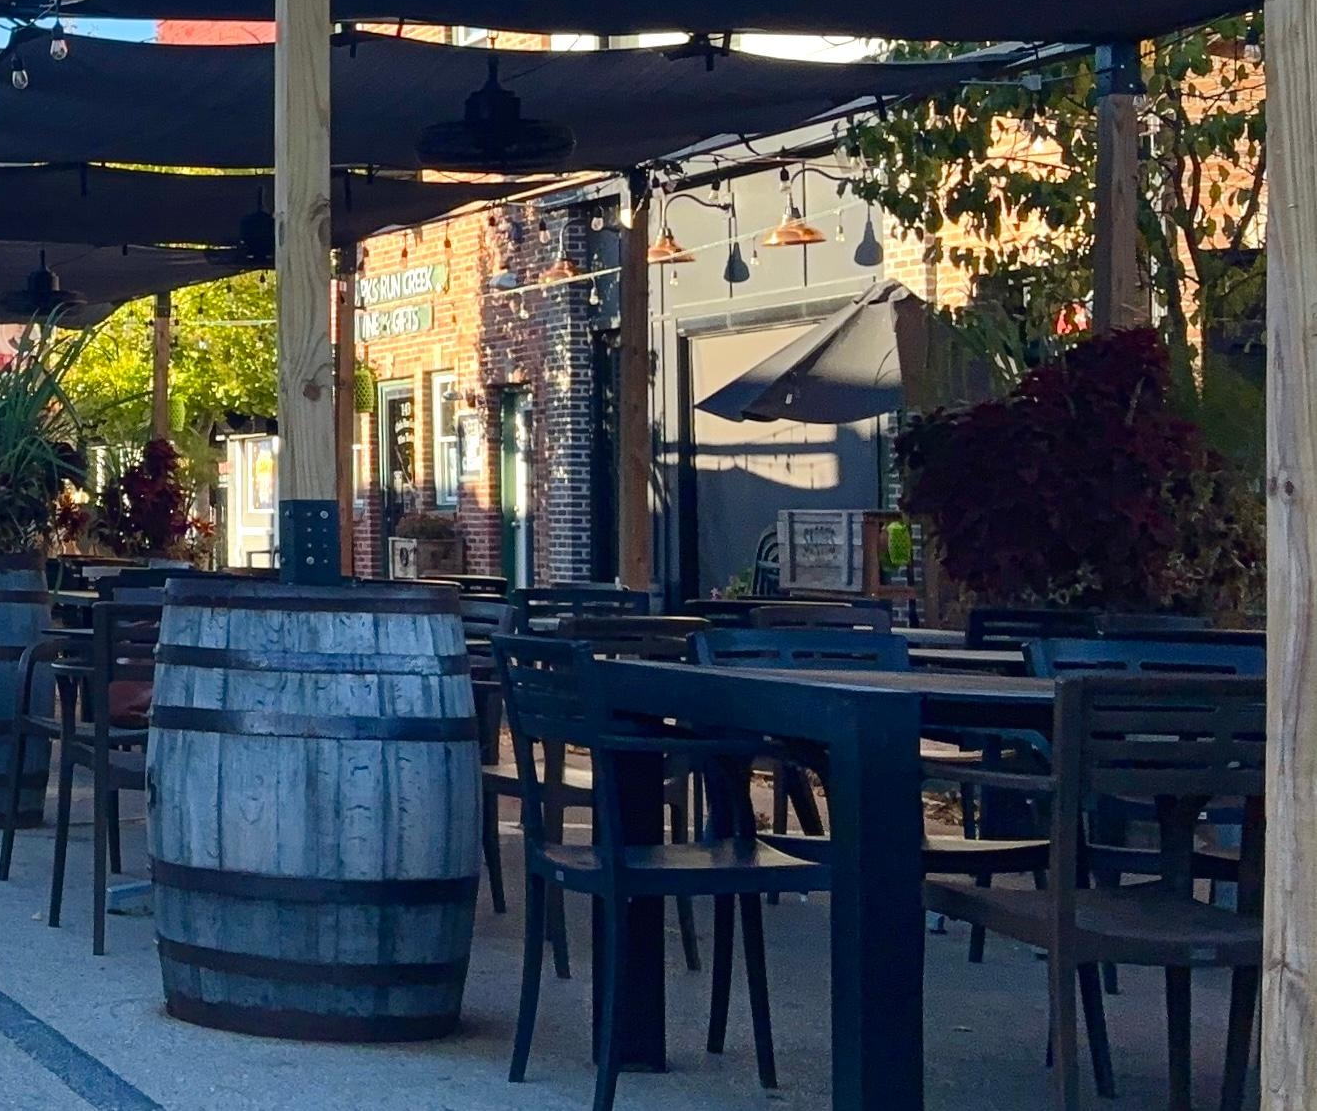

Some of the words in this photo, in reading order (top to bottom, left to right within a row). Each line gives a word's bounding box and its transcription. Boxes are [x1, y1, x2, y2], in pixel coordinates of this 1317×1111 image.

[380, 272, 401, 301] RUN
[402, 265, 434, 296] CREEK
[391, 305, 420, 336] GIFTS
